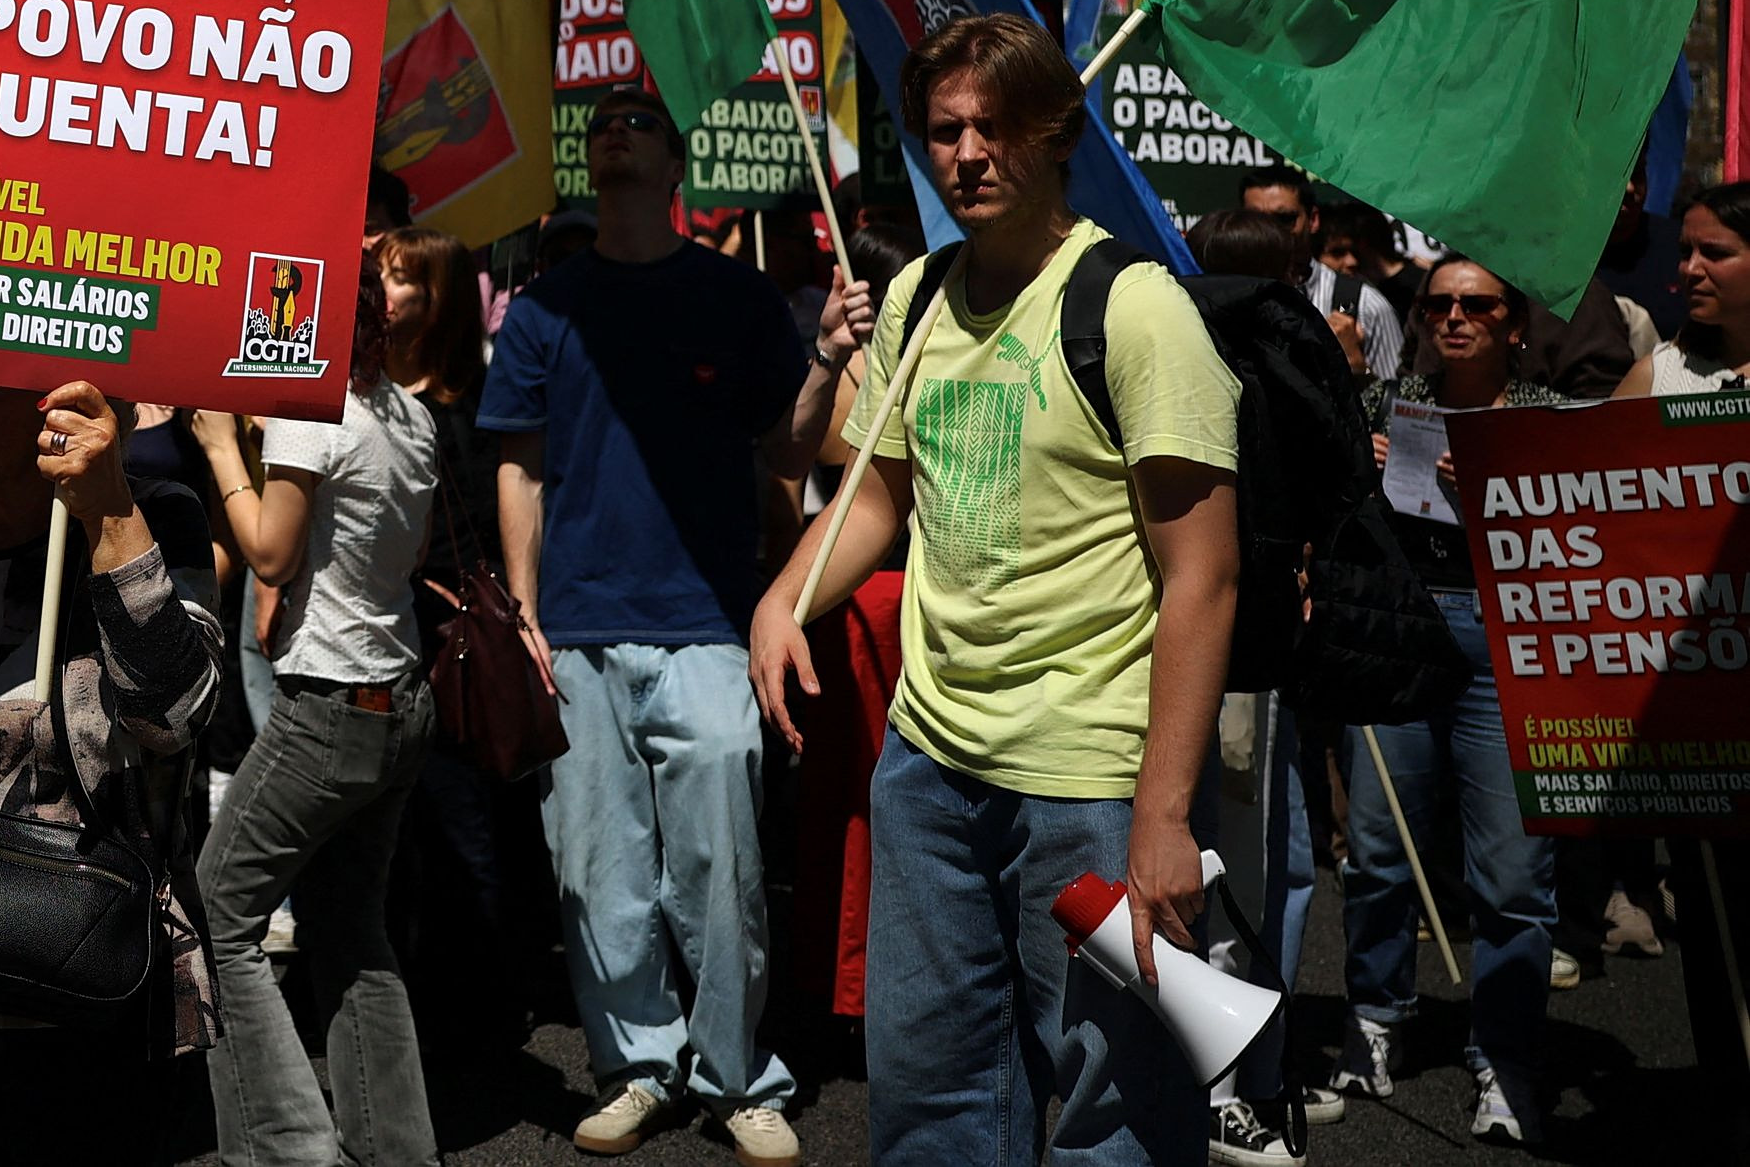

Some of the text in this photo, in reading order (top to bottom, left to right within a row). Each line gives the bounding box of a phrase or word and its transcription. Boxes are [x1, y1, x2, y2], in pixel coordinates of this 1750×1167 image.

[190, 7, 352, 94] NÃO
[1113, 63, 1192, 96] ABA
[1113, 97, 1137, 128] O
[690, 128, 711, 159] O
[64, 230, 222, 287] MELHOR
[17, 277, 150, 321] SALÁRIOS
[2, 314, 124, 355] DIREITOS
[245, 338, 310, 363] CGTP
[233, 364, 317, 373] INTERSINDICAL NACIONAL
[1486, 524, 1603, 571] DAS
[1497, 572, 1750, 624] REFORM
[1506, 616, 1750, 676] E PENSÕ
[1524, 713, 1639, 739] É POSSÍVEL
[1528, 742, 1591, 769] UMA
[1592, 741, 1656, 769] VIDA
[1534, 773, 1581, 793] MAIS
[1539, 795, 1551, 814] E
[1554, 795, 1641, 817] SERVIÇOS
